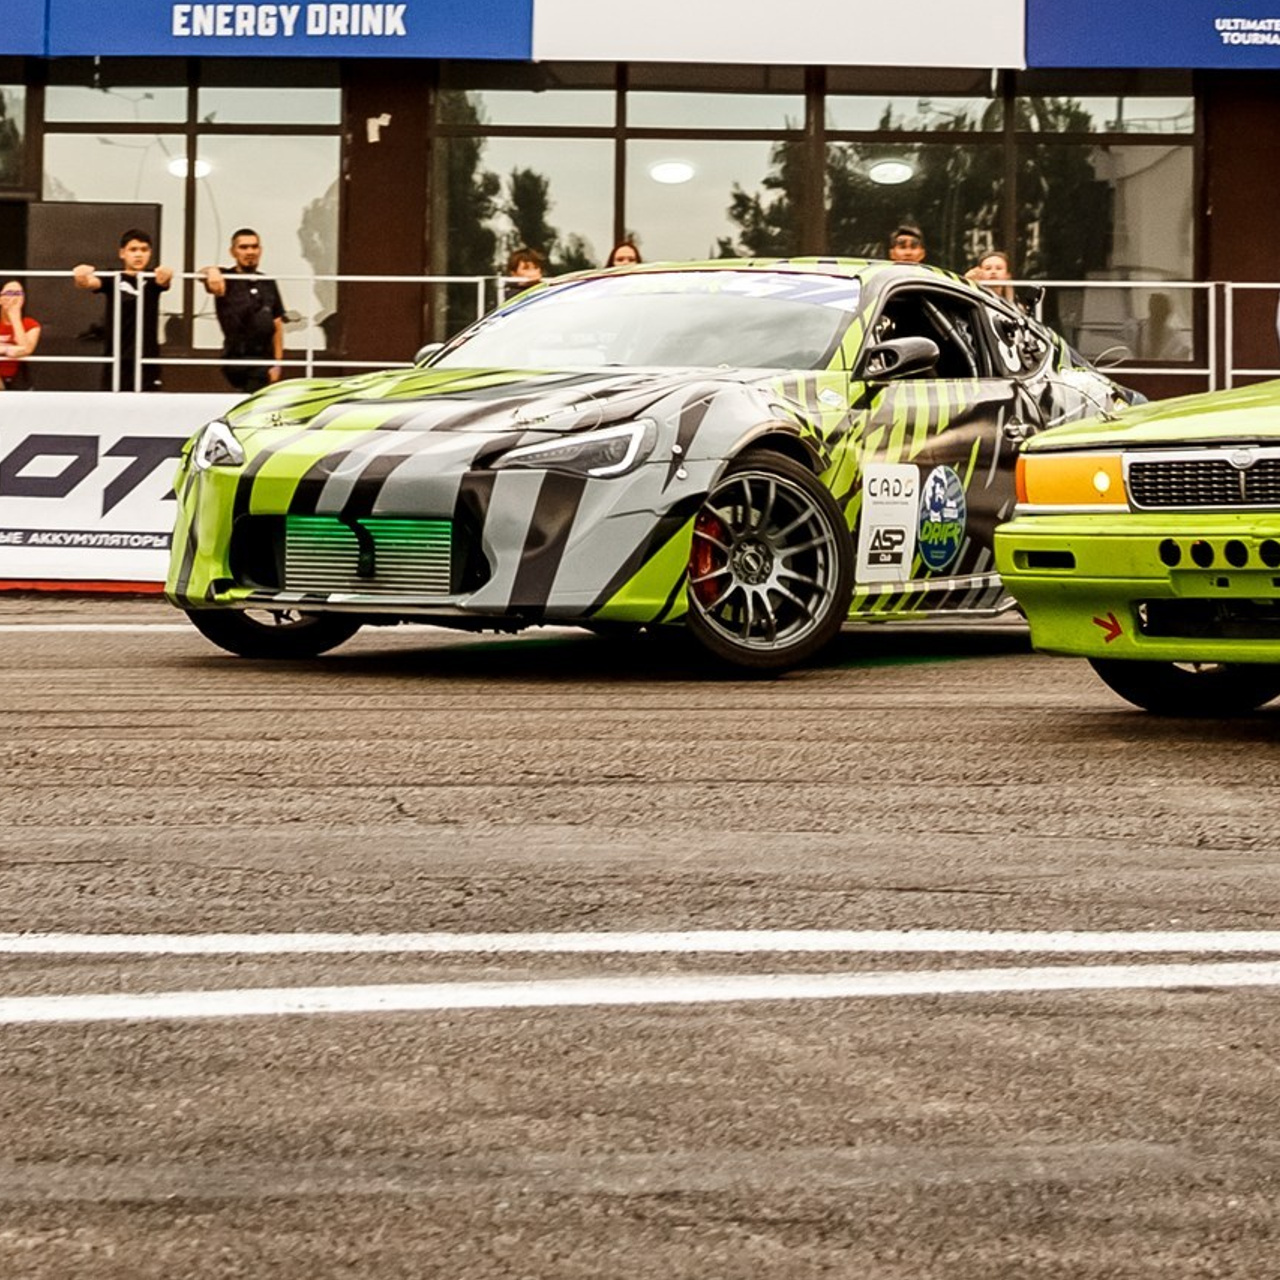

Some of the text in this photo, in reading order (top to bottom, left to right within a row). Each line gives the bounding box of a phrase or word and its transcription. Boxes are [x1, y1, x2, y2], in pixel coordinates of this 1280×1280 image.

[171, 3, 407, 37] ENERGY DRINK
[28, 532, 168, 547] АККУМУЛЯТОРЫ
[869, 529, 905, 551] ASP
